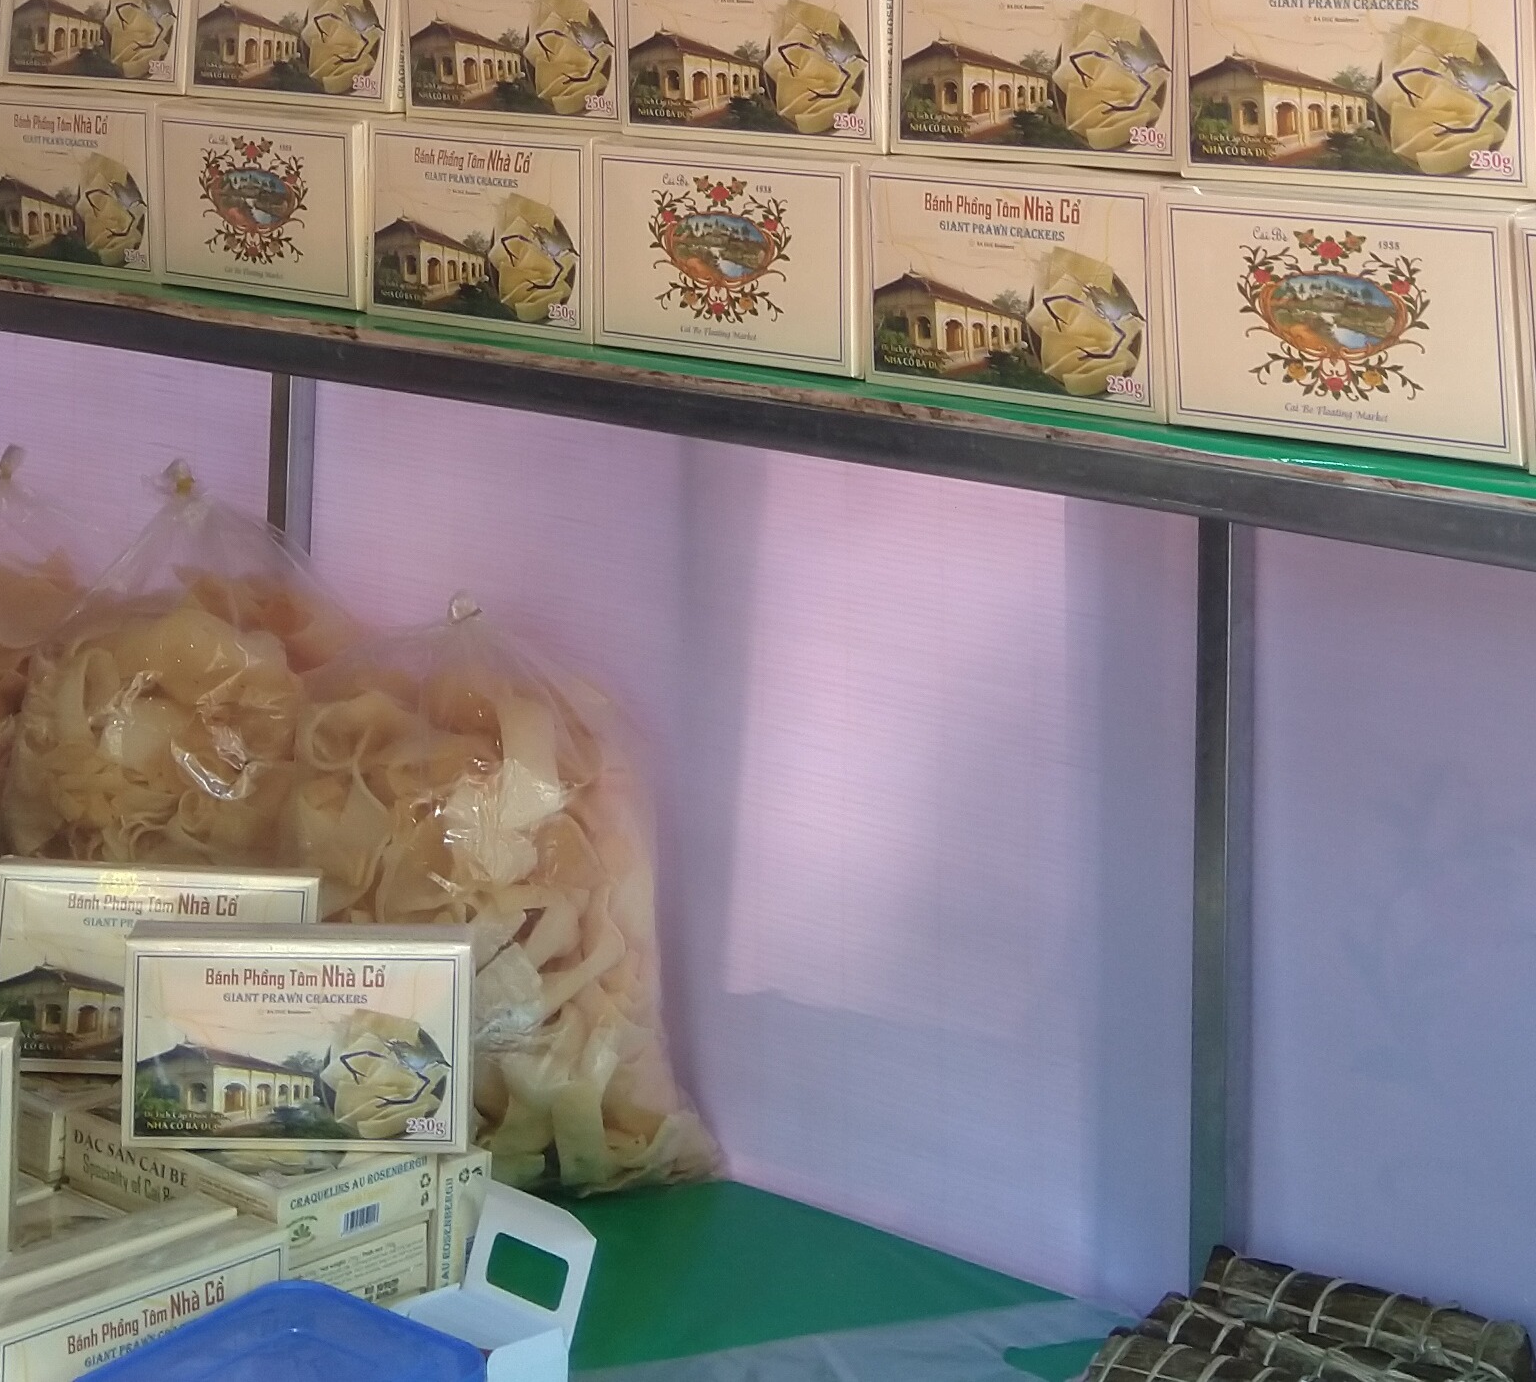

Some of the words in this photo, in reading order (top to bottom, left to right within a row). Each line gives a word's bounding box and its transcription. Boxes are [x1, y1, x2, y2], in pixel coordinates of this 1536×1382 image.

[833, 113, 865, 134] 250g
[1129, 127, 1165, 150] 250g
[1469, 150, 1513, 175] 250g
[925, 192, 953, 213] Bánh
[956, 195, 992, 220] Phồng
[995, 198, 1020, 219] Tôm
[1023, 195, 1053, 222] Nhà
[1059, 198, 1080, 224] Cổ
[939, 220, 970, 233] GIANT
[972, 223, 1008, 236] PRAWN
[1010, 226, 1065, 241] CRACKERS
[1106, 375, 1143, 401] 250g
[206, 968, 239, 985] Bánh
[243, 968, 285, 990] Phồng
[289, 969, 318, 986] Tôm
[321, 965, 356, 988] Nhà
[362, 964, 386, 988] Cổ
[222, 992, 259, 1002] GIANT
[261, 992, 303, 1003] PRAWN
[305, 993, 368, 1004] CRACKERS
[406, 1117, 445, 1137] 250g
[68, 1328, 98, 1355] Bánh
[101, 1318, 139, 1343] Phồng
[141, 1308, 167, 1328] Tôm
[170, 1290, 200, 1320] Nhà
[204, 1275, 225, 1306] Cổ
